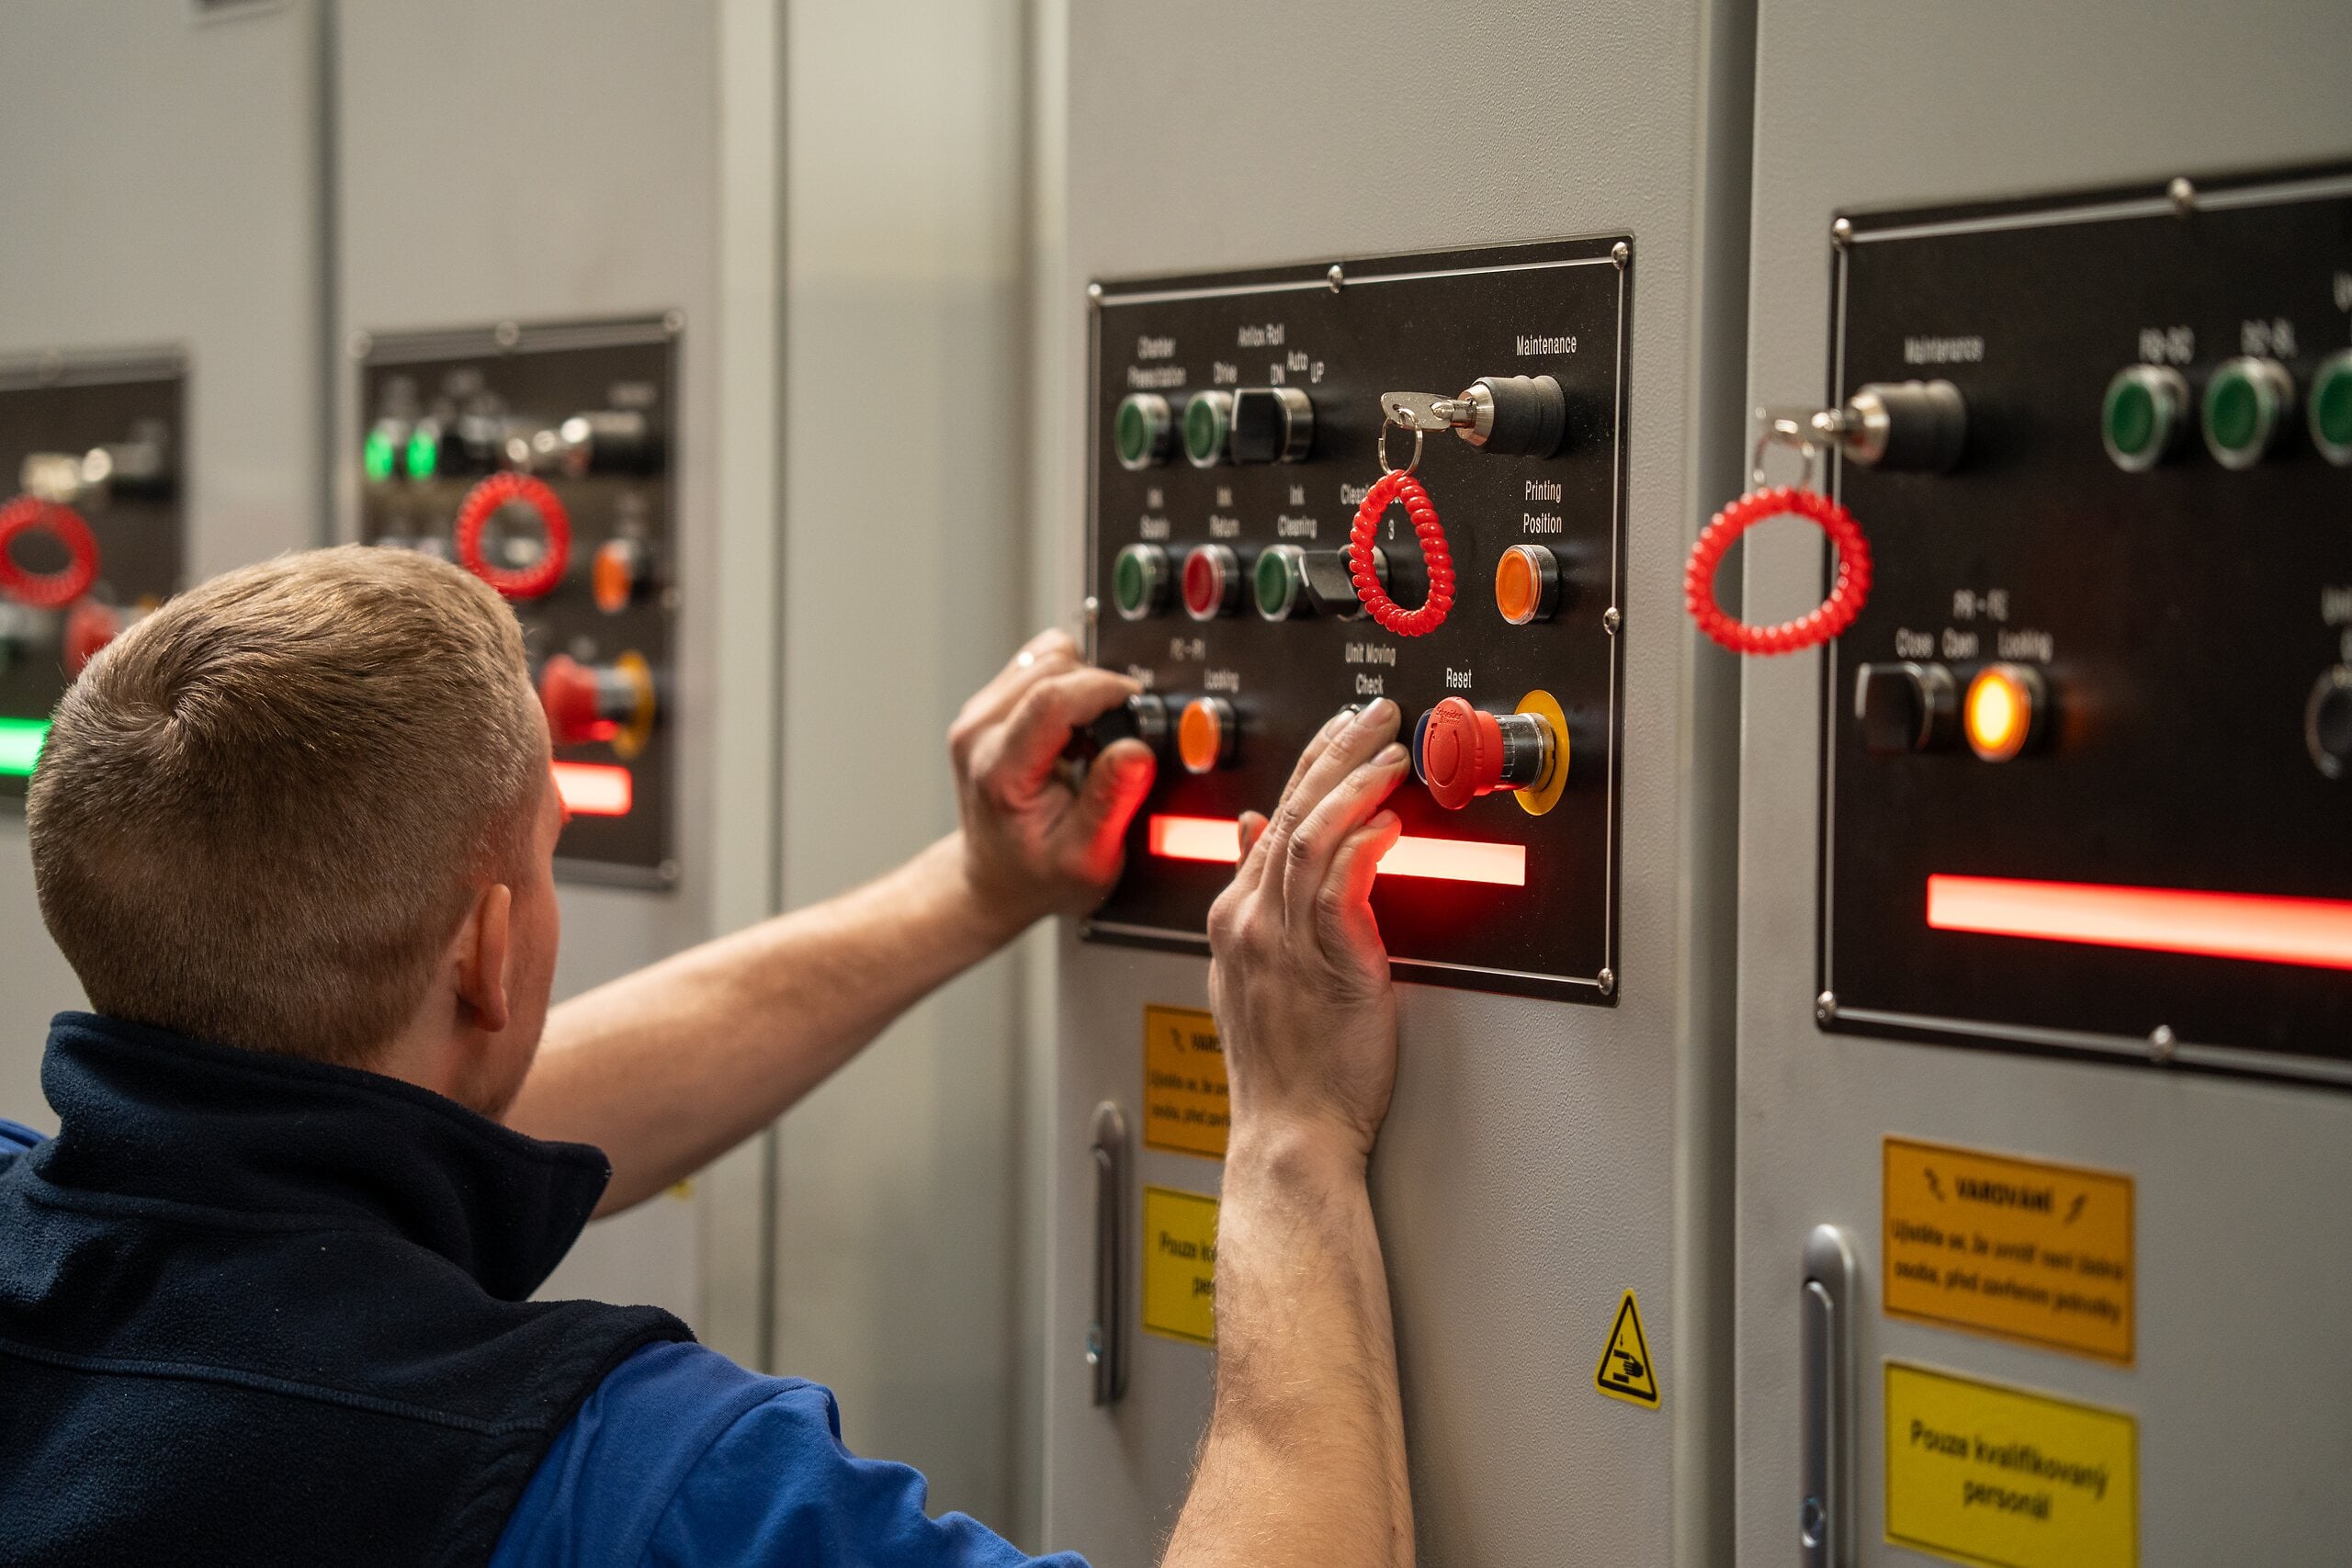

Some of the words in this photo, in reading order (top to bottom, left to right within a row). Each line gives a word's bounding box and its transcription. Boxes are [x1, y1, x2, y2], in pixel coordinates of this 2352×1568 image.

[1265, 322, 1285, 345] Roll
[1516, 334, 1577, 356] Maintenance
[1287, 349, 1309, 371] Auto
[1310, 361, 1325, 383] UP
[1289, 484, 1305, 506] Ink
[1525, 479, 1562, 503] Printing
[1277, 514, 1317, 540] Cleaning
[1523, 513, 1562, 534] Position
[1345, 642, 1364, 663] Unit
[1365, 642, 1396, 667] Moving
[1355, 672, 1385, 695] Check
[1446, 667, 1472, 689] Reset
[1910, 1417, 1969, 1459] Pouze
